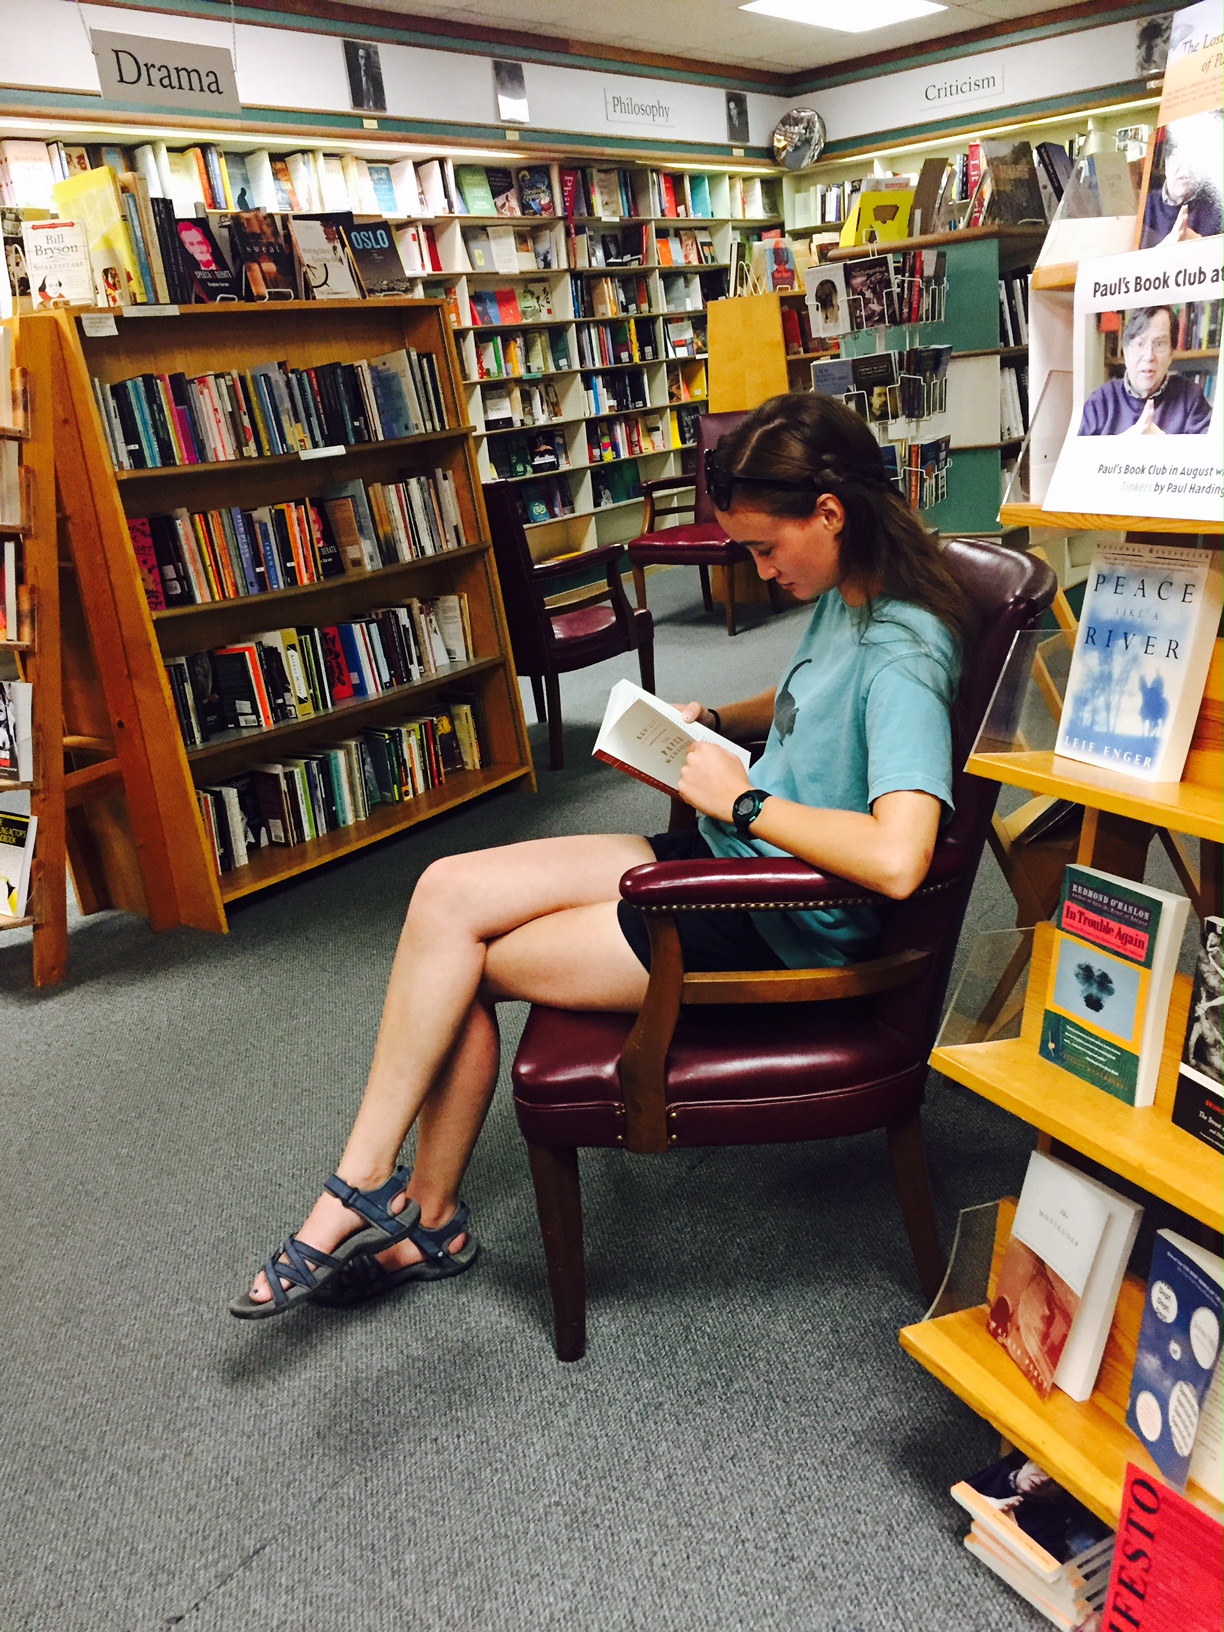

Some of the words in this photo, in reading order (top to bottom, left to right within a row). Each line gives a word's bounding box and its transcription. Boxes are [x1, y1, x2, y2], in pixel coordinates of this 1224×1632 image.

[1183, 39, 1198, 54] The
[111, 48, 223, 96] Drama
[1201, 55, 1214, 73] of
[924, 73, 997, 102] Criticism
[612, 96, 670, 123] Philosophy
[45, 233, 65, 245] Bill
[246, 245, 281, 253] sweat
[350, 229, 389, 250] OSLO
[34, 244, 79, 257] Bryson
[33, 261, 84, 272] SHAKESPEARE
[1093, 278, 1130, 298] Paul's
[1134, 272, 1170, 293] Book
[1175, 268, 1207, 288] Club
[1098, 463, 1122, 476] Paul's
[1124, 464, 1146, 476] Book
[1148, 464, 1167, 476] Club
[1169, 465, 1178, 476] in
[1180, 466, 1214, 480] August
[1121, 481, 1152, 493] Tinkers
[1153, 482, 1165, 494] by
[1166, 482, 1188, 494] Paul
[1188, 483, 1224, 498] Harding
[1094, 573, 1196, 604] PEACE
[1115, 606, 1144, 619] LIKE
[1153, 611, 1159, 621] A
[1085, 625, 1180, 660] RIVER
[1065, 735, 1096, 753] LEIF
[1103, 745, 1153, 768] ENGER
[1072, 883, 1109, 904] REDMOND
[1110, 898, 1150, 921] O'HANLON
[1065, 905, 1076, 921] In
[1077, 909, 1115, 936] Trouble
[1115, 926, 1146, 951] Again
[1199, 1110, 1208, 1120] The
[1108, 1477, 1161, 1632] FESTO
